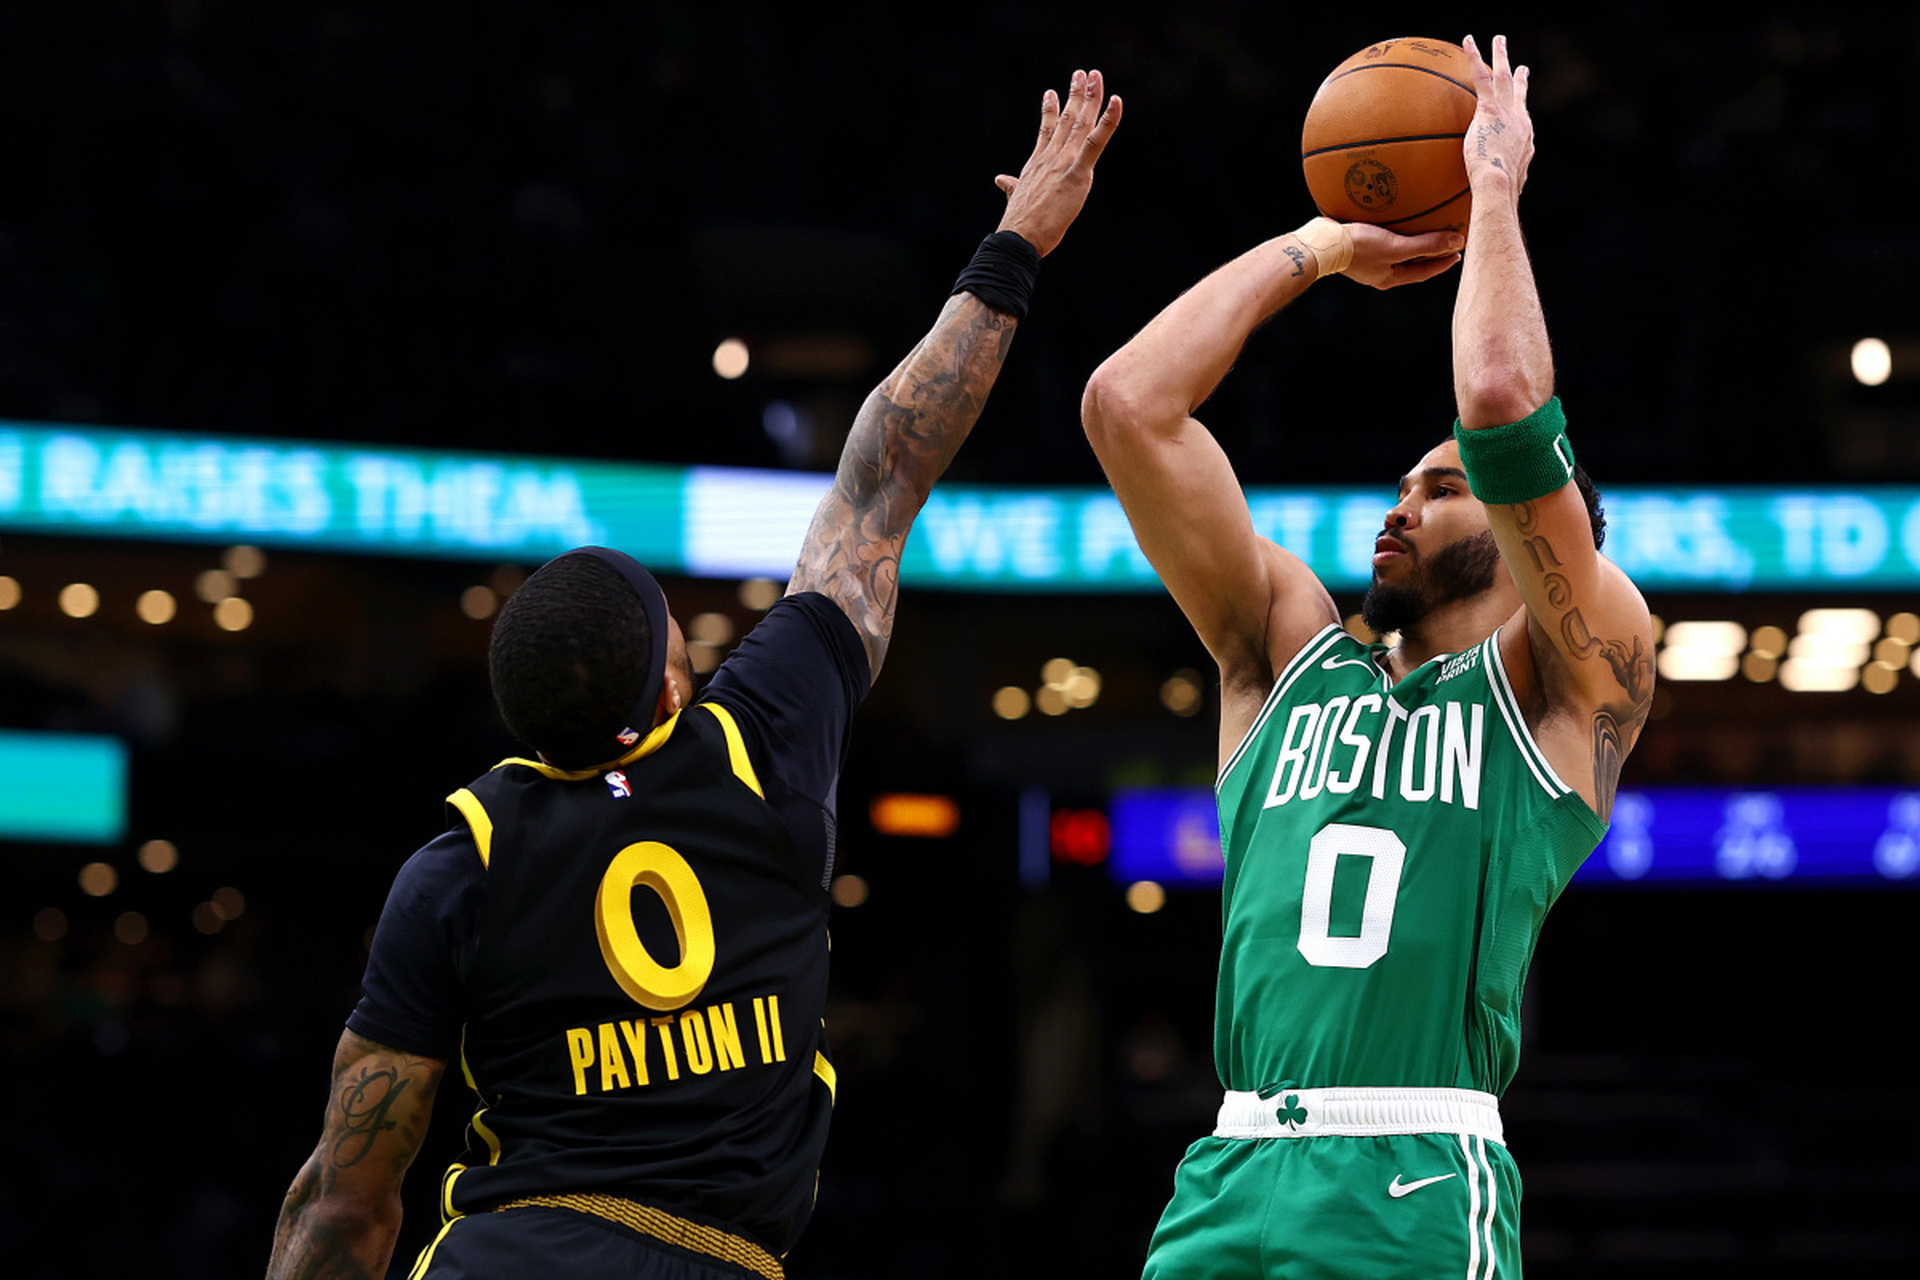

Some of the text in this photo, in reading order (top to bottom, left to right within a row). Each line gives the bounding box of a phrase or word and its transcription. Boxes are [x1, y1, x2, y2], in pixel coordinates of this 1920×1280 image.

[1510, 502, 1603, 660] Deuc
[1434, 655, 1479, 686] PRINT
[1263, 692, 1484, 811] BOSTON
[593, 840, 716, 1012] 0
[1297, 822, 1408, 969] 0
[565, 994, 787, 1096] PAYTON II
